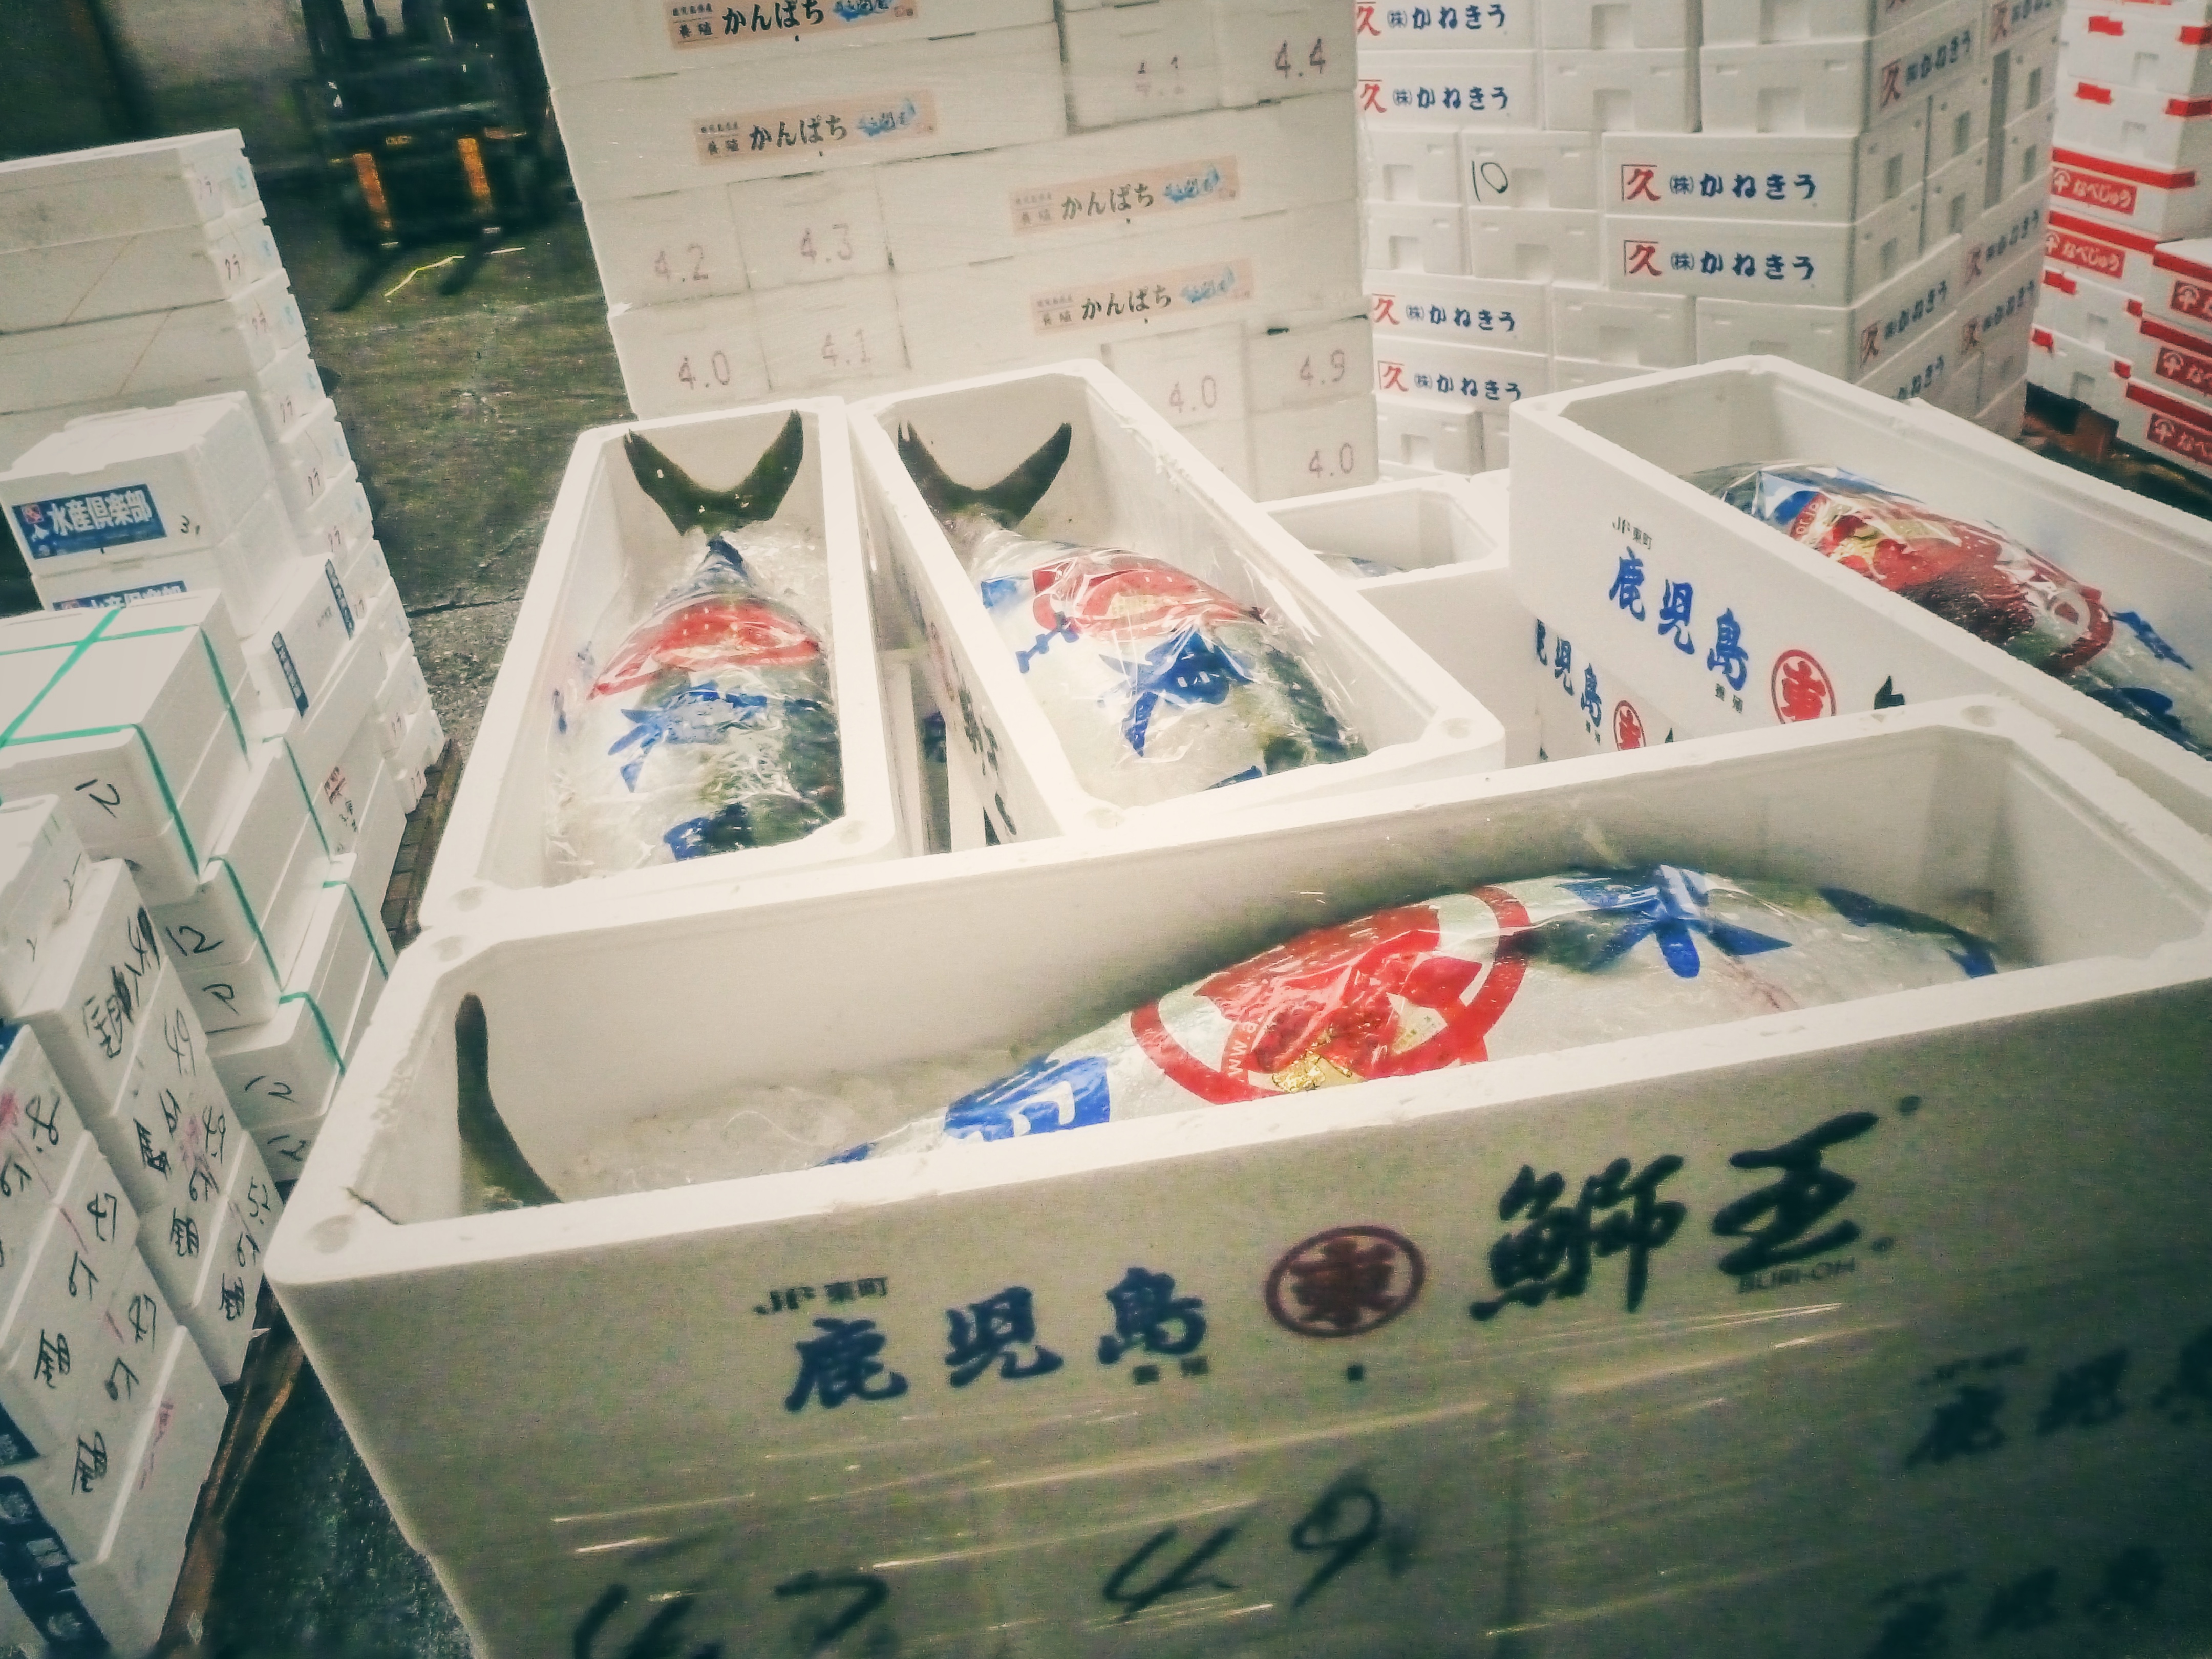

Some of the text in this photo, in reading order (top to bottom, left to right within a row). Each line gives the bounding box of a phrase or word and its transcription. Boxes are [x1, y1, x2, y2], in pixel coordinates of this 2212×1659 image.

[1275, 37, 1326, 80] 4.4
[678, 350, 731, 390] 4.0
[1169, 374, 1217, 414] 4.0
[1309, 442, 1354, 479] 4.0
[47, 489, 153, 537] 水産倶楽部
[1609, 546, 1749, 691] 鹿児島
[783, 1266, 1209, 1413] 鹿児島
[1469, 1110, 1881, 1321] 鰤王
